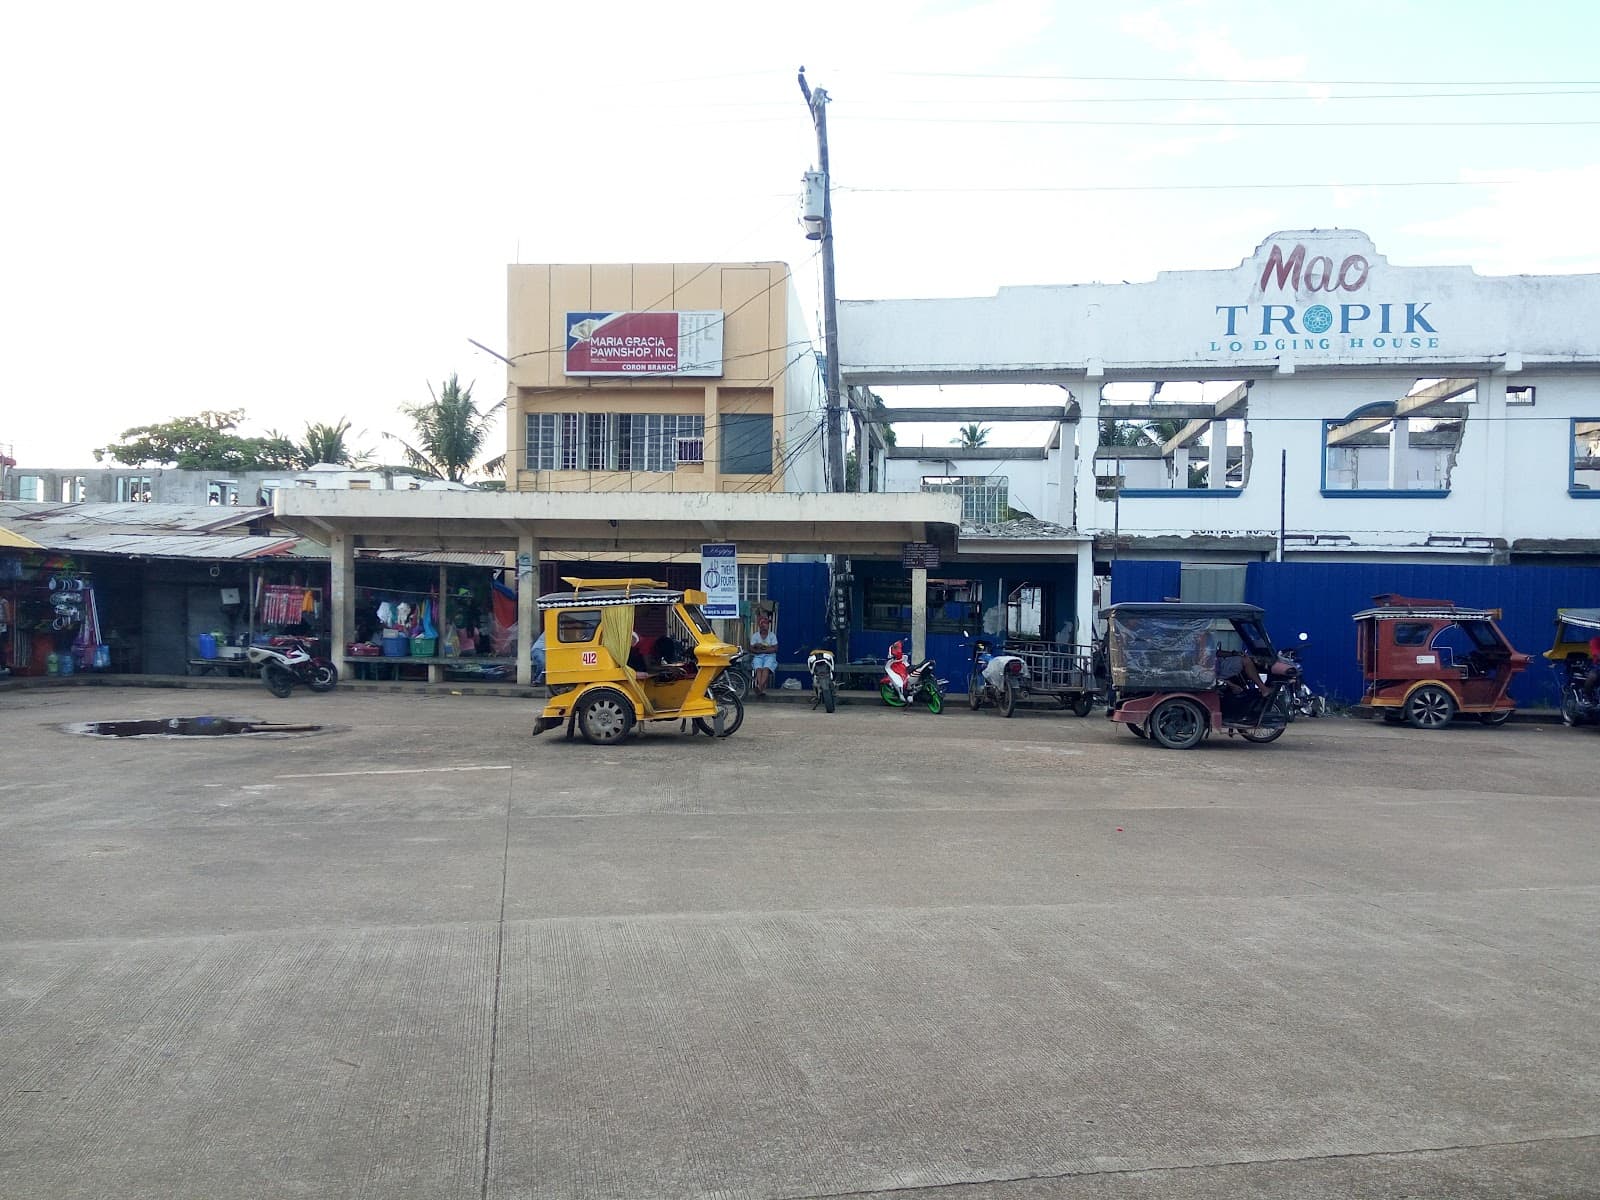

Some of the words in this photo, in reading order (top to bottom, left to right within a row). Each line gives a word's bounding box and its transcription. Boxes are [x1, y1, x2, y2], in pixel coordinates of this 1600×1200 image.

[1260, 243, 1373, 293] Mao
[1215, 302, 1439, 336] TROPIK
[590, 336, 624, 347] MARIA
[625, 336, 665, 347] GRACIA
[1209, 338, 1330, 352] LODGING
[1350, 337, 1439, 348] HOUSE
[590, 347, 653, 358] PAWNSHOP,
[655, 347, 676, 357] INC.
[583, 652, 597, 665] 412
